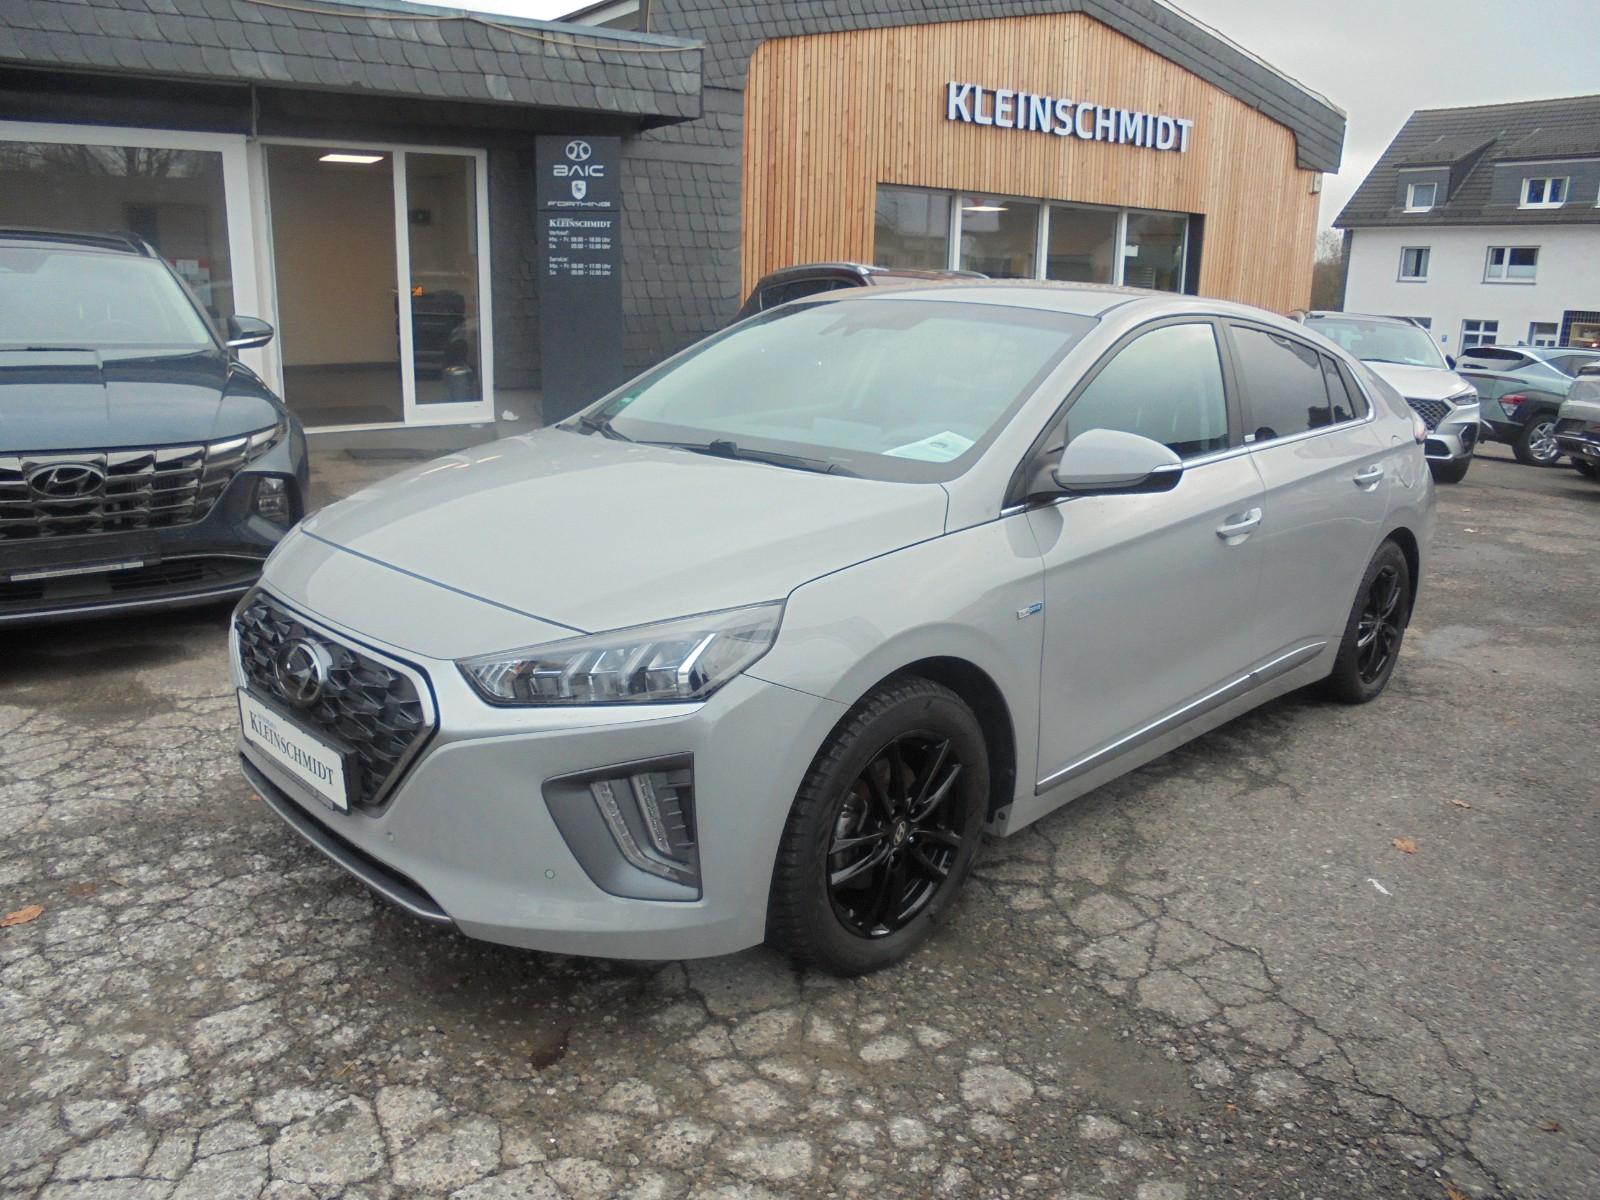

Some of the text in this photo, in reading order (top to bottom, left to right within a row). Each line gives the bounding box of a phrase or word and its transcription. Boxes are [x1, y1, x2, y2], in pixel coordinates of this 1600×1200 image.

[947, 80, 1194, 153] KLEINSCHMIDT
[553, 164, 604, 177] BAIC
[549, 219, 612, 228] KLEINSCHMIDT
[249, 710, 334, 785] KLEINSCHMIDT
